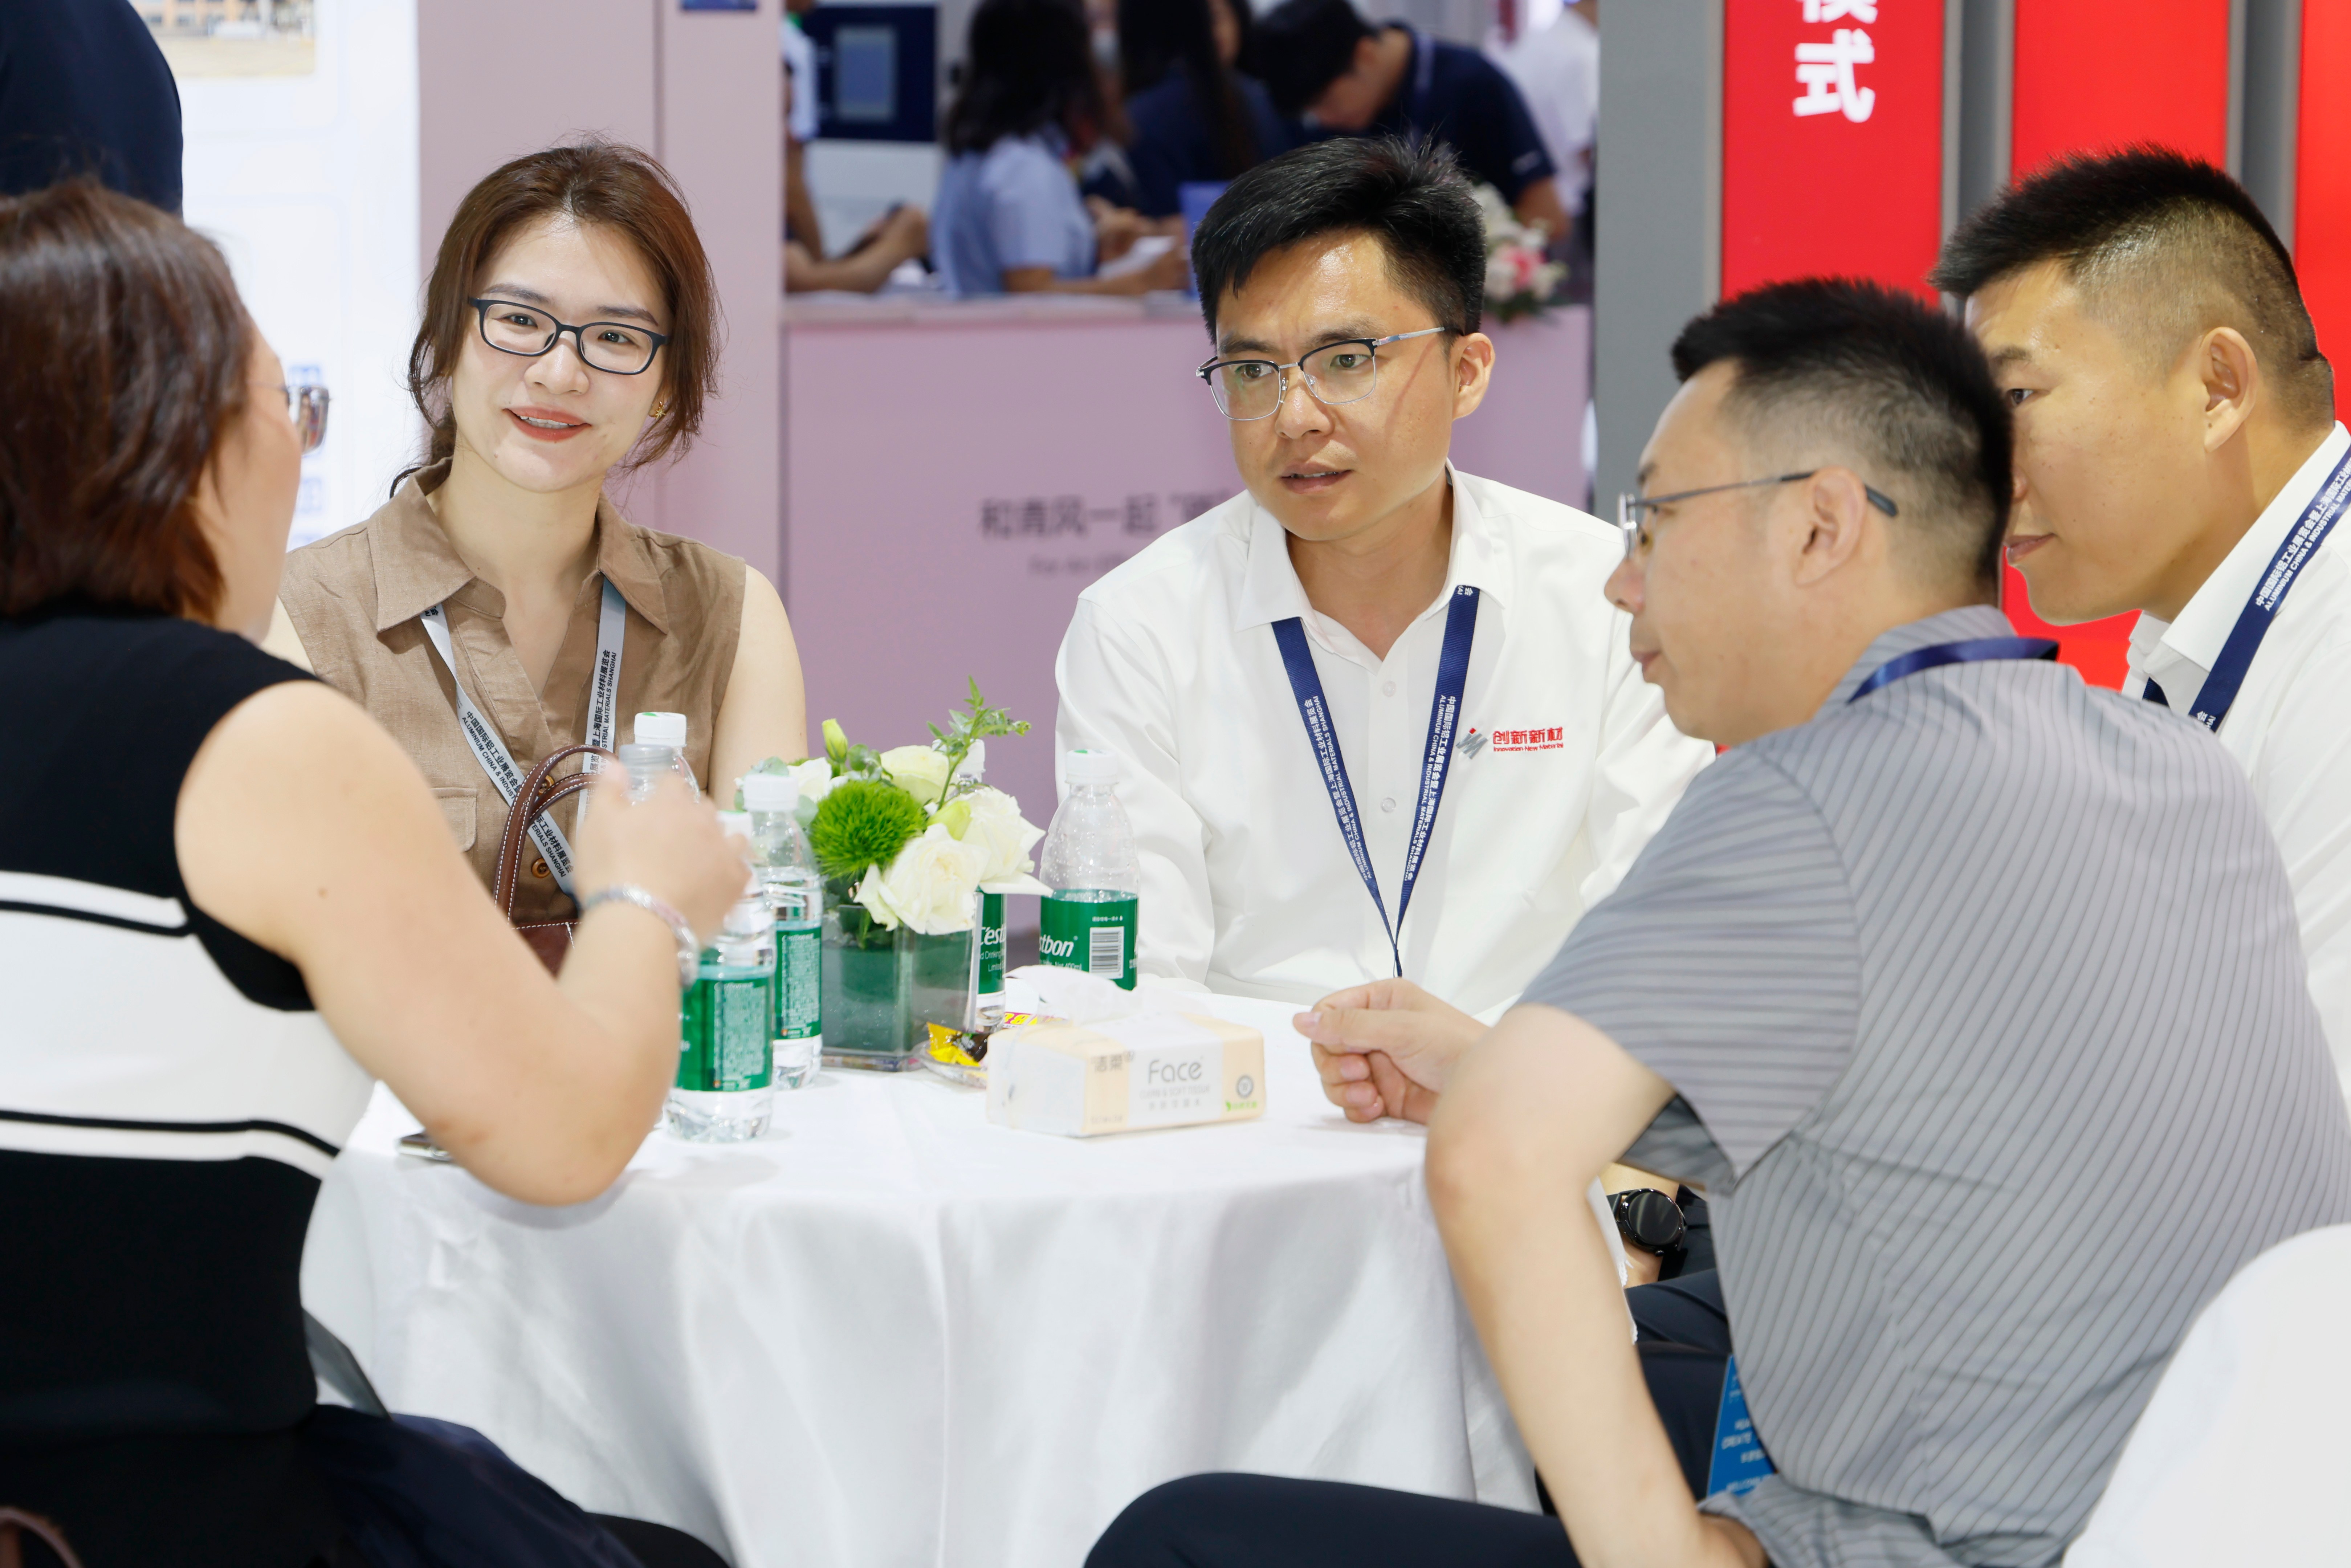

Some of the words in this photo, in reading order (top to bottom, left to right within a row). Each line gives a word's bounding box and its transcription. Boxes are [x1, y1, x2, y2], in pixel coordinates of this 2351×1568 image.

[1792, 0, 1878, 123] 式
[2264, 569, 2294, 611] ALUMINIUM
[2290, 547, 2309, 571] CHINA
[2308, 502, 2340, 542] INDUSTRIAL
[2335, 477, 2351, 503] MATER
[607, 652, 616, 687] SHANGHAI
[1312, 696, 1328, 731] SHANGHAI
[1434, 695, 1446, 734] ALUMINIUM
[1324, 732, 1340, 771] MATERIALS
[1430, 734, 1439, 756] CHINA
[1492, 726, 1563, 745] 创新新材
[462, 717, 485, 752] ALUMINIUM
[482, 751, 497, 771] CHINA
[499, 776, 516, 799] INDUST
[1304, 699, 1368, 881] 中国国际铝工业展览会暨上海国际工业材料展览会
[1335, 771, 1352, 812] INDUSTRIAL
[1407, 696, 1456, 881] 中国国际铝工业展览会暨上海国际工业材料展览会
[1421, 763, 1433, 805] INDUSTRIAL
[1413, 806, 1427, 844] MATERIALS
[532, 823, 548, 847] ERIALS
[546, 847, 566, 877] SHANGHAI
[1356, 842, 1372, 879] ALUMINIUM
[1404, 846, 1416, 881] SHANGHAI
[1039, 934, 1074, 957] stbon
[1148, 1058, 1202, 1084] Face
